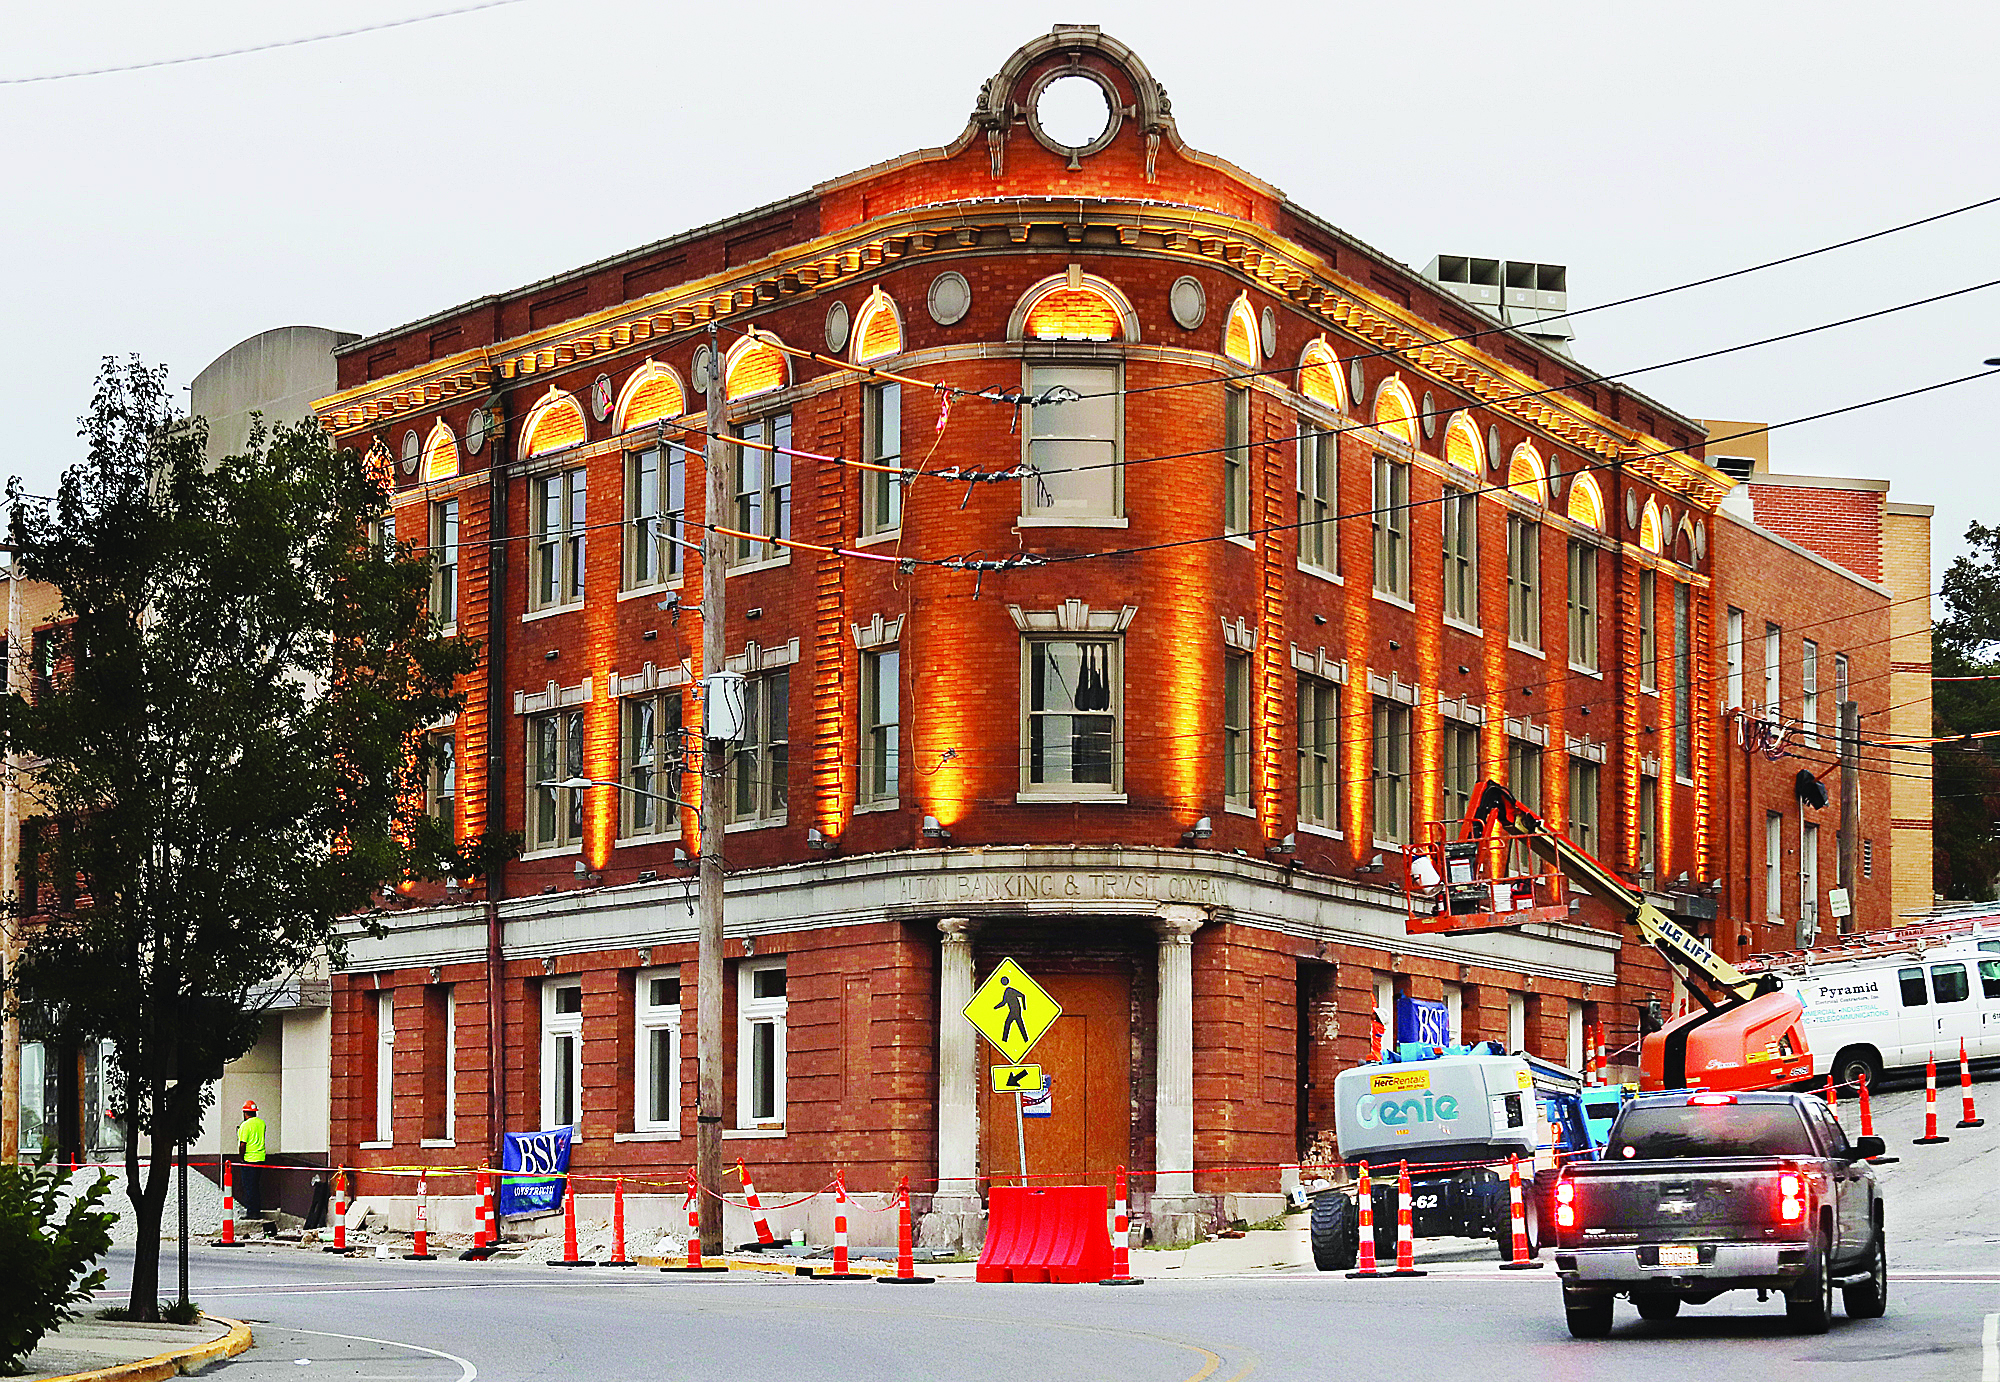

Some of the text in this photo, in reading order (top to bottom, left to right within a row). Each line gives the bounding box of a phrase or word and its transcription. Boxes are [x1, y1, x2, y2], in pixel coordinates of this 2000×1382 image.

[900, 877, 948, 900] ALTON
[957, 875, 1052, 898] BANKING
[1064, 874, 1081, 896] &
[1168, 877, 1229, 901] COMPANY
[1658, 921, 1711, 963] JLG LIFT
[1819, 982, 1878, 998] Pyramid
[1417, 1005, 1446, 1047] BSI
[1815, 1010, 1889, 1023] TELECOMMUNICATIONS
[1356, 1089, 1459, 1129] Genie
[516, 1133, 557, 1174] BSI
[1411, 1194, 1438, 1209] -62
